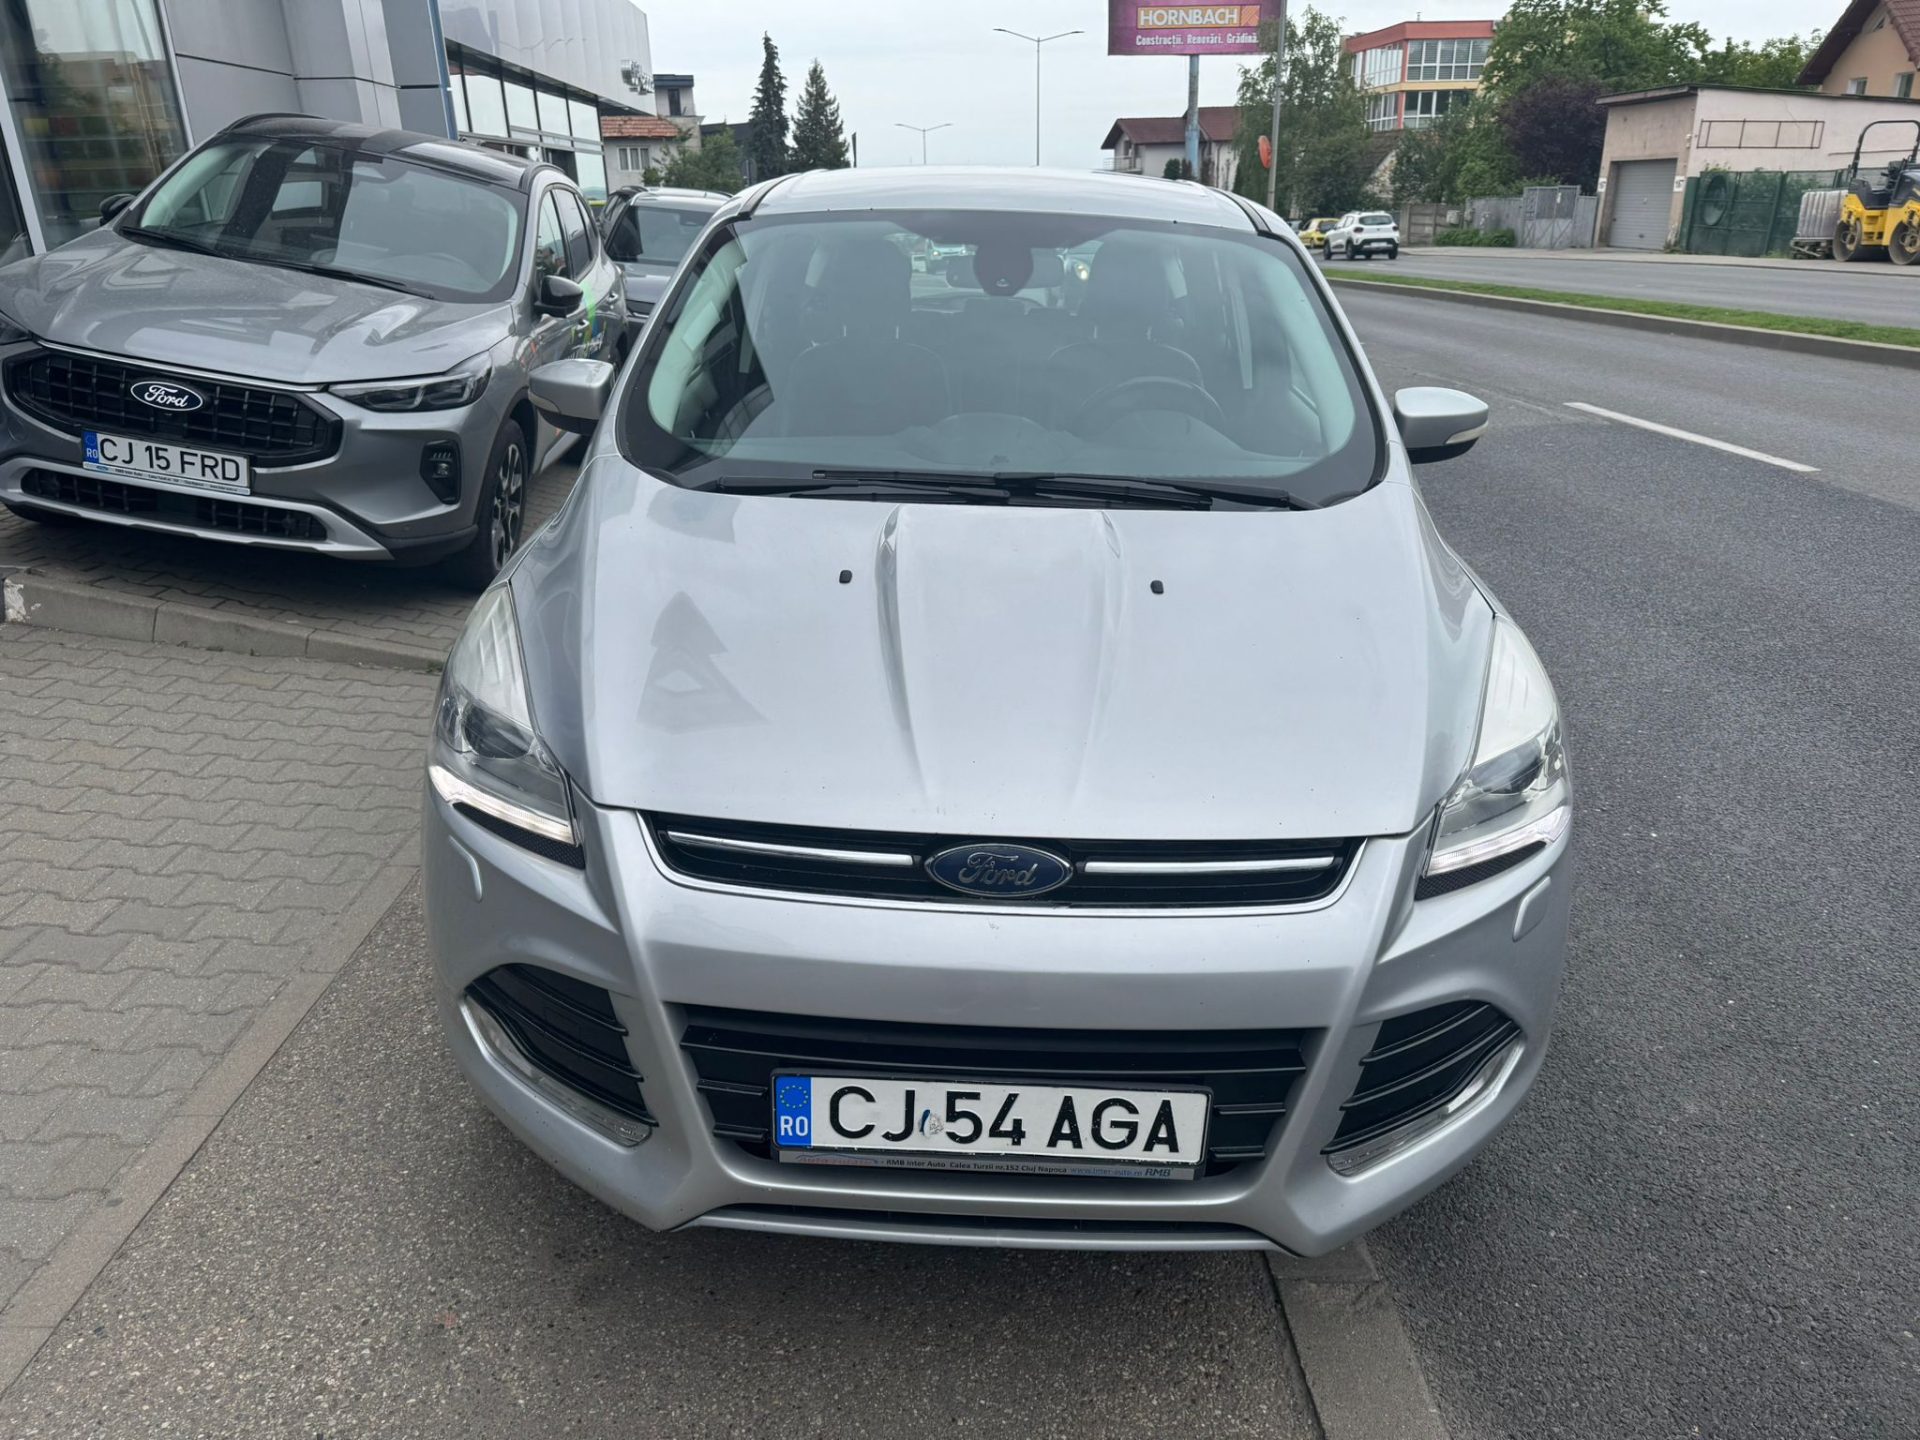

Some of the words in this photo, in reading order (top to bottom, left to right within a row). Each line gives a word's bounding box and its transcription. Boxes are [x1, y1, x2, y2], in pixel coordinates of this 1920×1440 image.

[1139, 8, 1239, 26] HORNBACH
[144, 384, 188, 408] Ford
[86, 447, 98, 459] RO
[100, 438, 134, 464] CJ
[144, 445, 171, 471] 15
[179, 450, 240, 482] FRD
[958, 852, 1038, 886] Ford
[780, 1115, 809, 1137] RO
[829, 1085, 915, 1142] CJ
[945, 1091, 1026, 1146] 54
[1046, 1095, 1180, 1153] AGA
[927, 1160, 946, 1168] Auto
[1021, 1163, 1036, 1173] Cluj
[1038, 1165, 1067, 1174] Napoca
[1144, 1168, 1171, 1177] RMB
